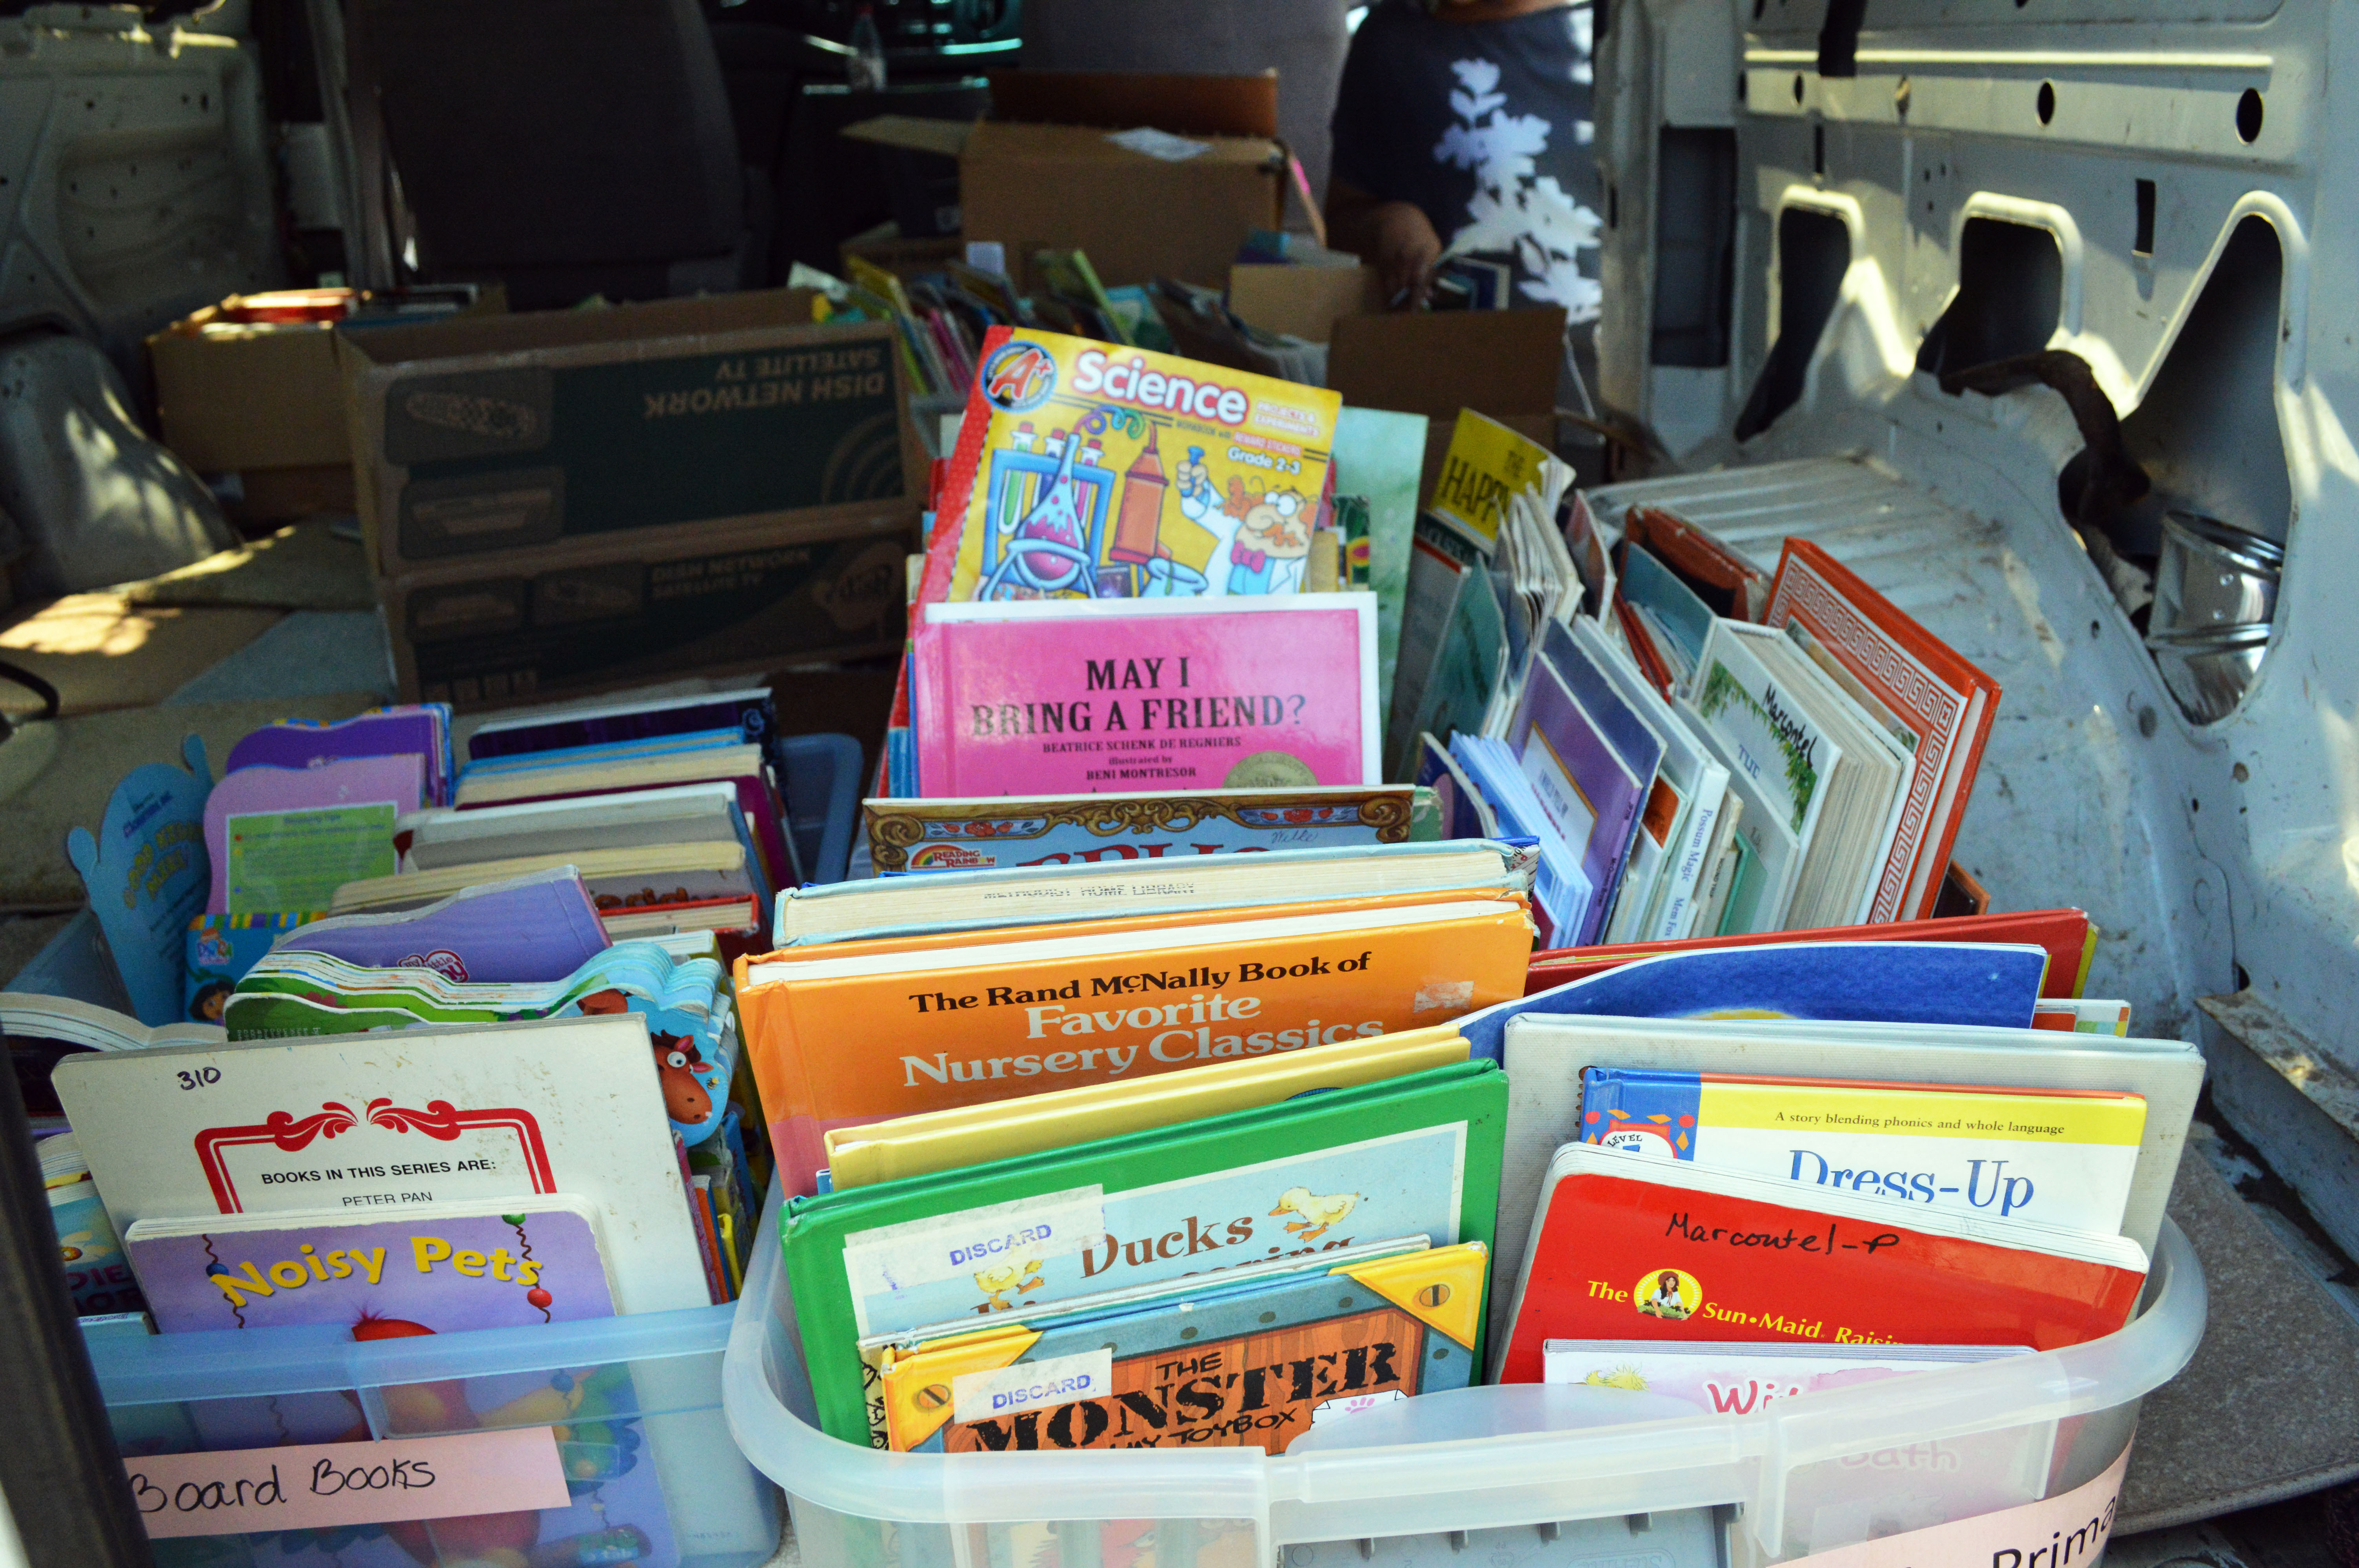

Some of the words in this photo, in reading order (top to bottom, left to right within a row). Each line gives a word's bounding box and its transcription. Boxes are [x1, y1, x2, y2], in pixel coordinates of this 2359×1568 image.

[714, 359, 746, 381] TV
[754, 347, 881, 378] SATELLITE
[642, 379, 804, 419] NETWORK
[810, 370, 886, 402] DISH
[1073, 350, 1247, 424] Science
[1228, 446, 1273, 469] Grade
[1275, 457, 1301, 475] 2-3
[1085, 658, 1164, 691] MAY
[1178, 657, 1190, 687] I
[971, 702, 1092, 737] BRING
[1104, 700, 1129, 731] A
[1141, 694, 1307, 730] FRIEND?
[1043, 741, 1103, 753] BEATRICE
[1106, 739, 1156, 751] SCHENK
[1160, 739, 1176, 750] DE
[1179, 737, 1242, 749] REGNIERS
[1109, 755, 1160, 765] illustrated
[1161, 755, 1173, 765] by
[1086, 769, 1116, 781] BENI
[1119, 767, 1197, 779] MONTRESOR
[1692, 808, 1714, 848] Possum
[933, 850, 980, 862] READING
[1681, 850, 1701, 882] Magic
[1081, 885, 1128, 896] HOME
[1132, 882, 1195, 895] LIBRARY
[1669, 897, 1685, 920] Mem
[1665, 918, 1677, 937] Fox
[908, 992, 980, 1013] The
[985, 980, 1081, 1006] Rand
[1090, 966, 1231, 996] McNally
[1238, 956, 1331, 982] Book
[1337, 951, 1372, 972] of
[1024, 994, 1261, 1038] Favorite
[899, 1044, 1139, 1087] Nursery
[1148, 1019, 1384, 1062] Classics
[176, 1066, 222, 1091] 310
[1775, 1112, 1785, 1122] A
[1790, 1113, 1821, 1125] story
[1826, 1113, 1879, 1127] blending
[1884, 1116, 1933, 1129] phonics
[1937, 1118, 1961, 1129] and
[1965, 1119, 2004, 1131] whole
[2008, 1121, 2065, 1136] language
[1607, 1134, 1643, 1147] LEVEL
[261, 1170, 322, 1185] BOOKS
[326, 1168, 343, 1181] IN
[347, 1165, 386, 1179] THIS
[391, 1161, 451, 1176] SERIES
[457, 1158, 497, 1171] ARE:
[1789, 1149, 2034, 1217] Dress-Up
[343, 1194, 396, 1207] PETER
[402, 1191, 433, 1203] PAN
[949, 1224, 1052, 1266] DISCARD
[1074, 1215, 1253, 1279] Ducks
[210, 1243, 386, 1308] Noisy
[410, 1236, 543, 1287] Pets
[1587, 1280, 1628, 1303] The
[1156, 1352, 1224, 1381] THE
[966, 1342, 1401, 1452] MONSTER
[992, 1374, 1096, 1410] DISCARD
[1168, 1410, 1298, 1443] TOYBOX
[129, 1463, 287, 1513] Board
[310, 1458, 436, 1495] Books
[1993, 1495, 2116, 1568] Prima
